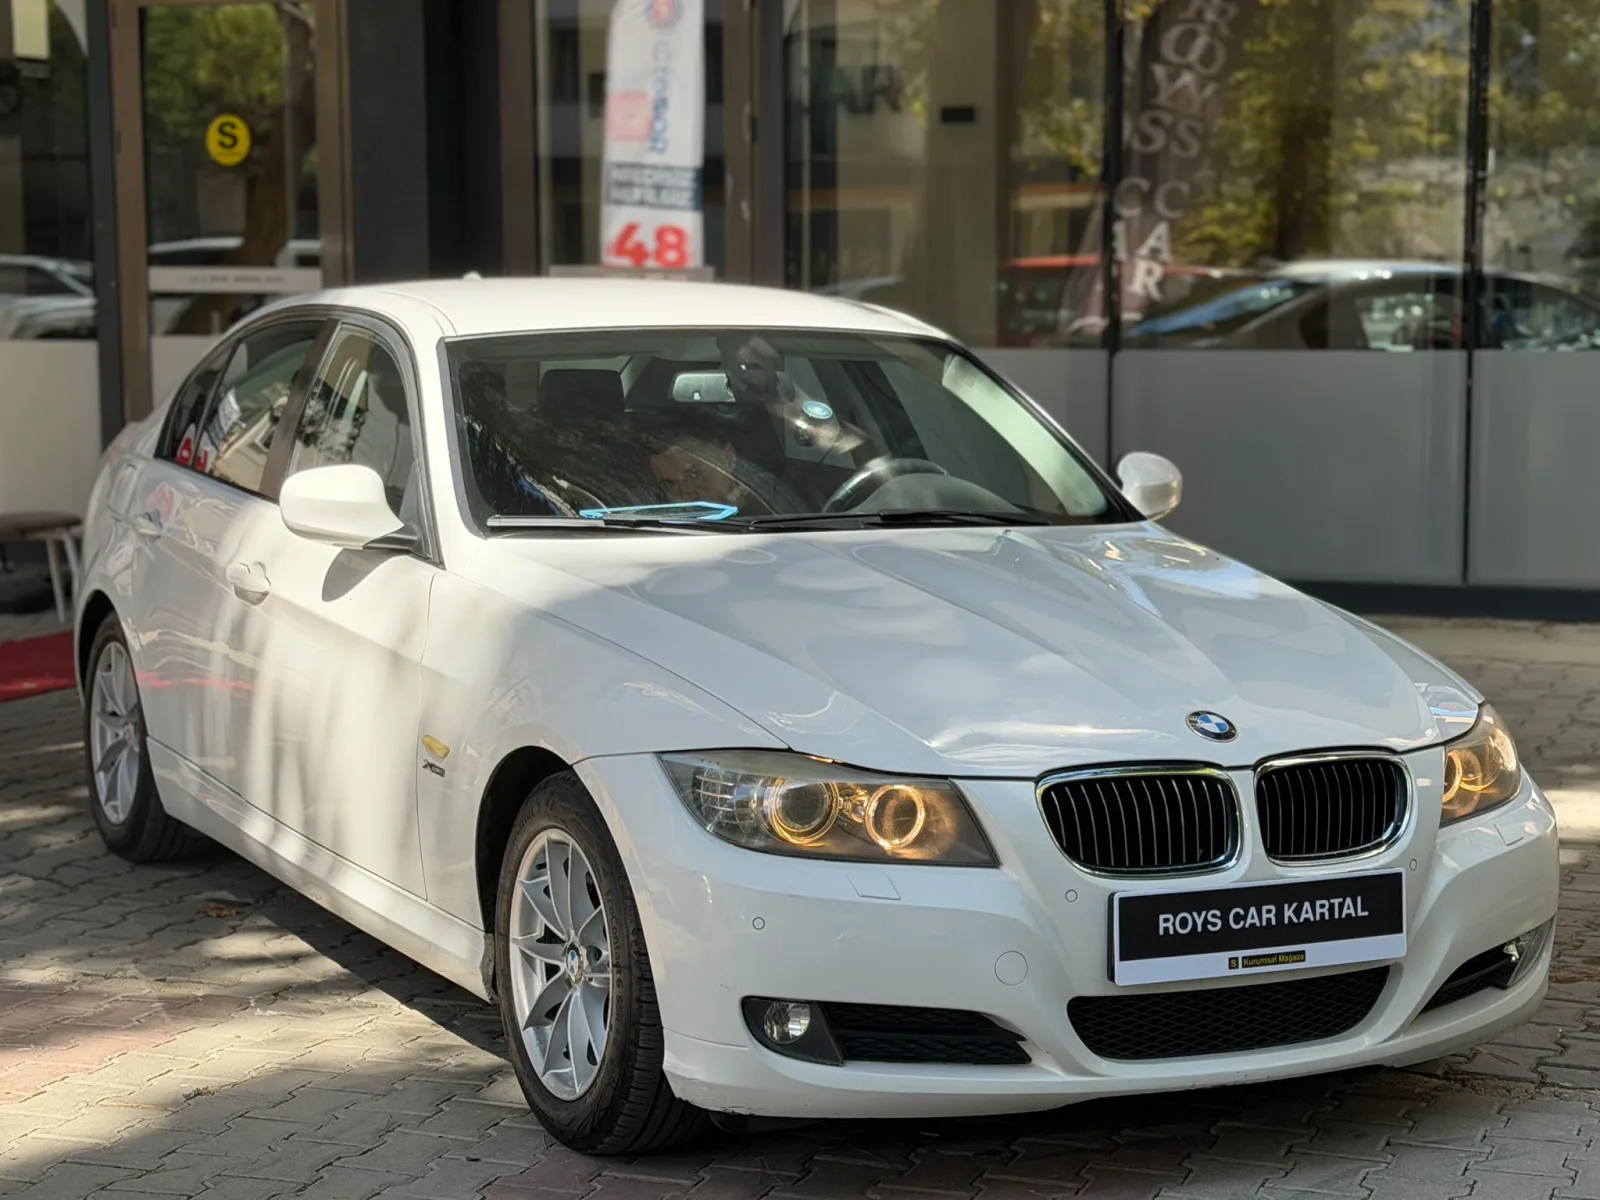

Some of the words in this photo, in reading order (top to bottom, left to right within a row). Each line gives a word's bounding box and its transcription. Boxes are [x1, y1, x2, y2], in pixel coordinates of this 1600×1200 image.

[216, 120, 239, 150] S
[608, 221, 690, 269] 48
[1158, 909, 1222, 936] ROYS
[1228, 904, 1277, 930] CAR
[1283, 895, 1369, 925] KARTAL
[1230, 958, 1238, 968] S
[1243, 955, 1277, 966] Kurumsal
